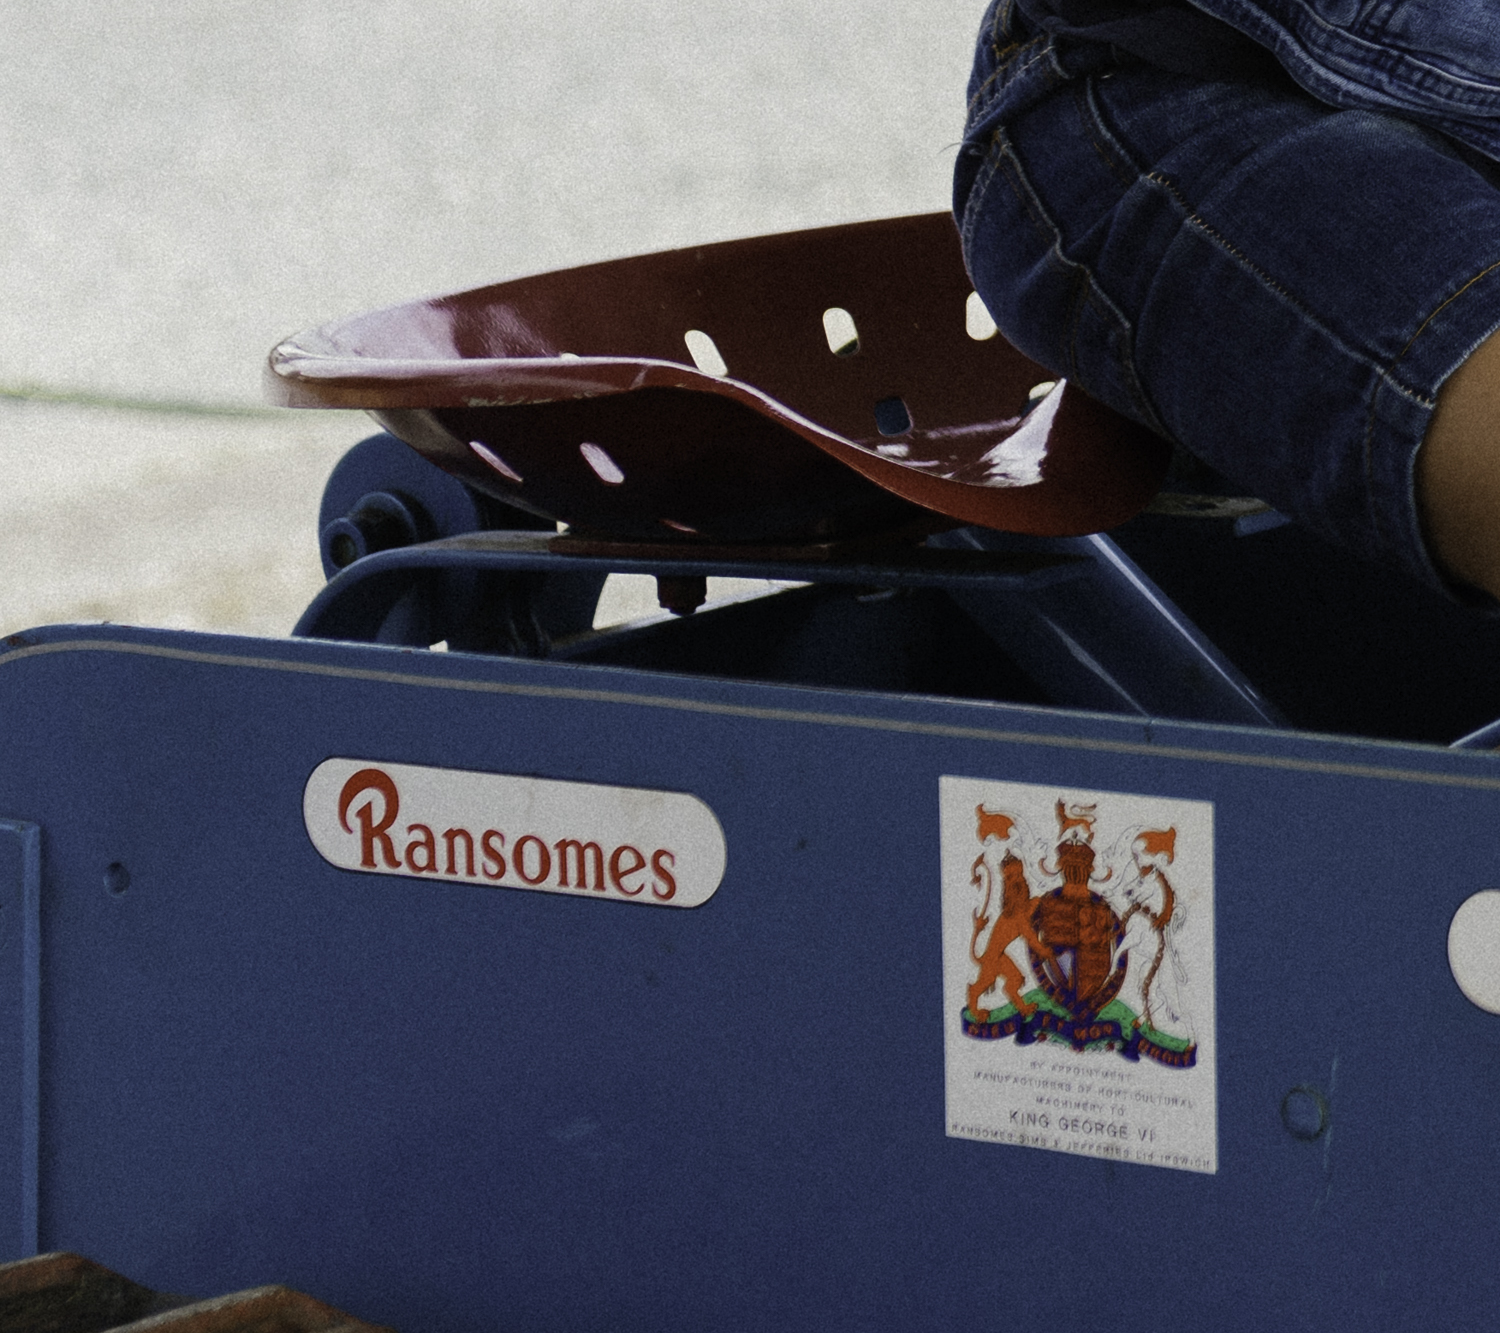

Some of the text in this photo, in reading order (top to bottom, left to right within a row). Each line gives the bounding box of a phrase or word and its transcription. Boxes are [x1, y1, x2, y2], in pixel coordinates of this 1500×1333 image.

[337, 768, 677, 901] Ransomes
[1074, 1024, 1113, 1040] MON
[1051, 1063, 1132, 1082] APPOINTMENT
[973, 1071, 1194, 1110] MANUFACTURERS OF HORTICULTURAL
[1036, 1096, 1124, 1117] MACHINERY TO
[1009, 1108, 1155, 1143] KING GEORGE VI
